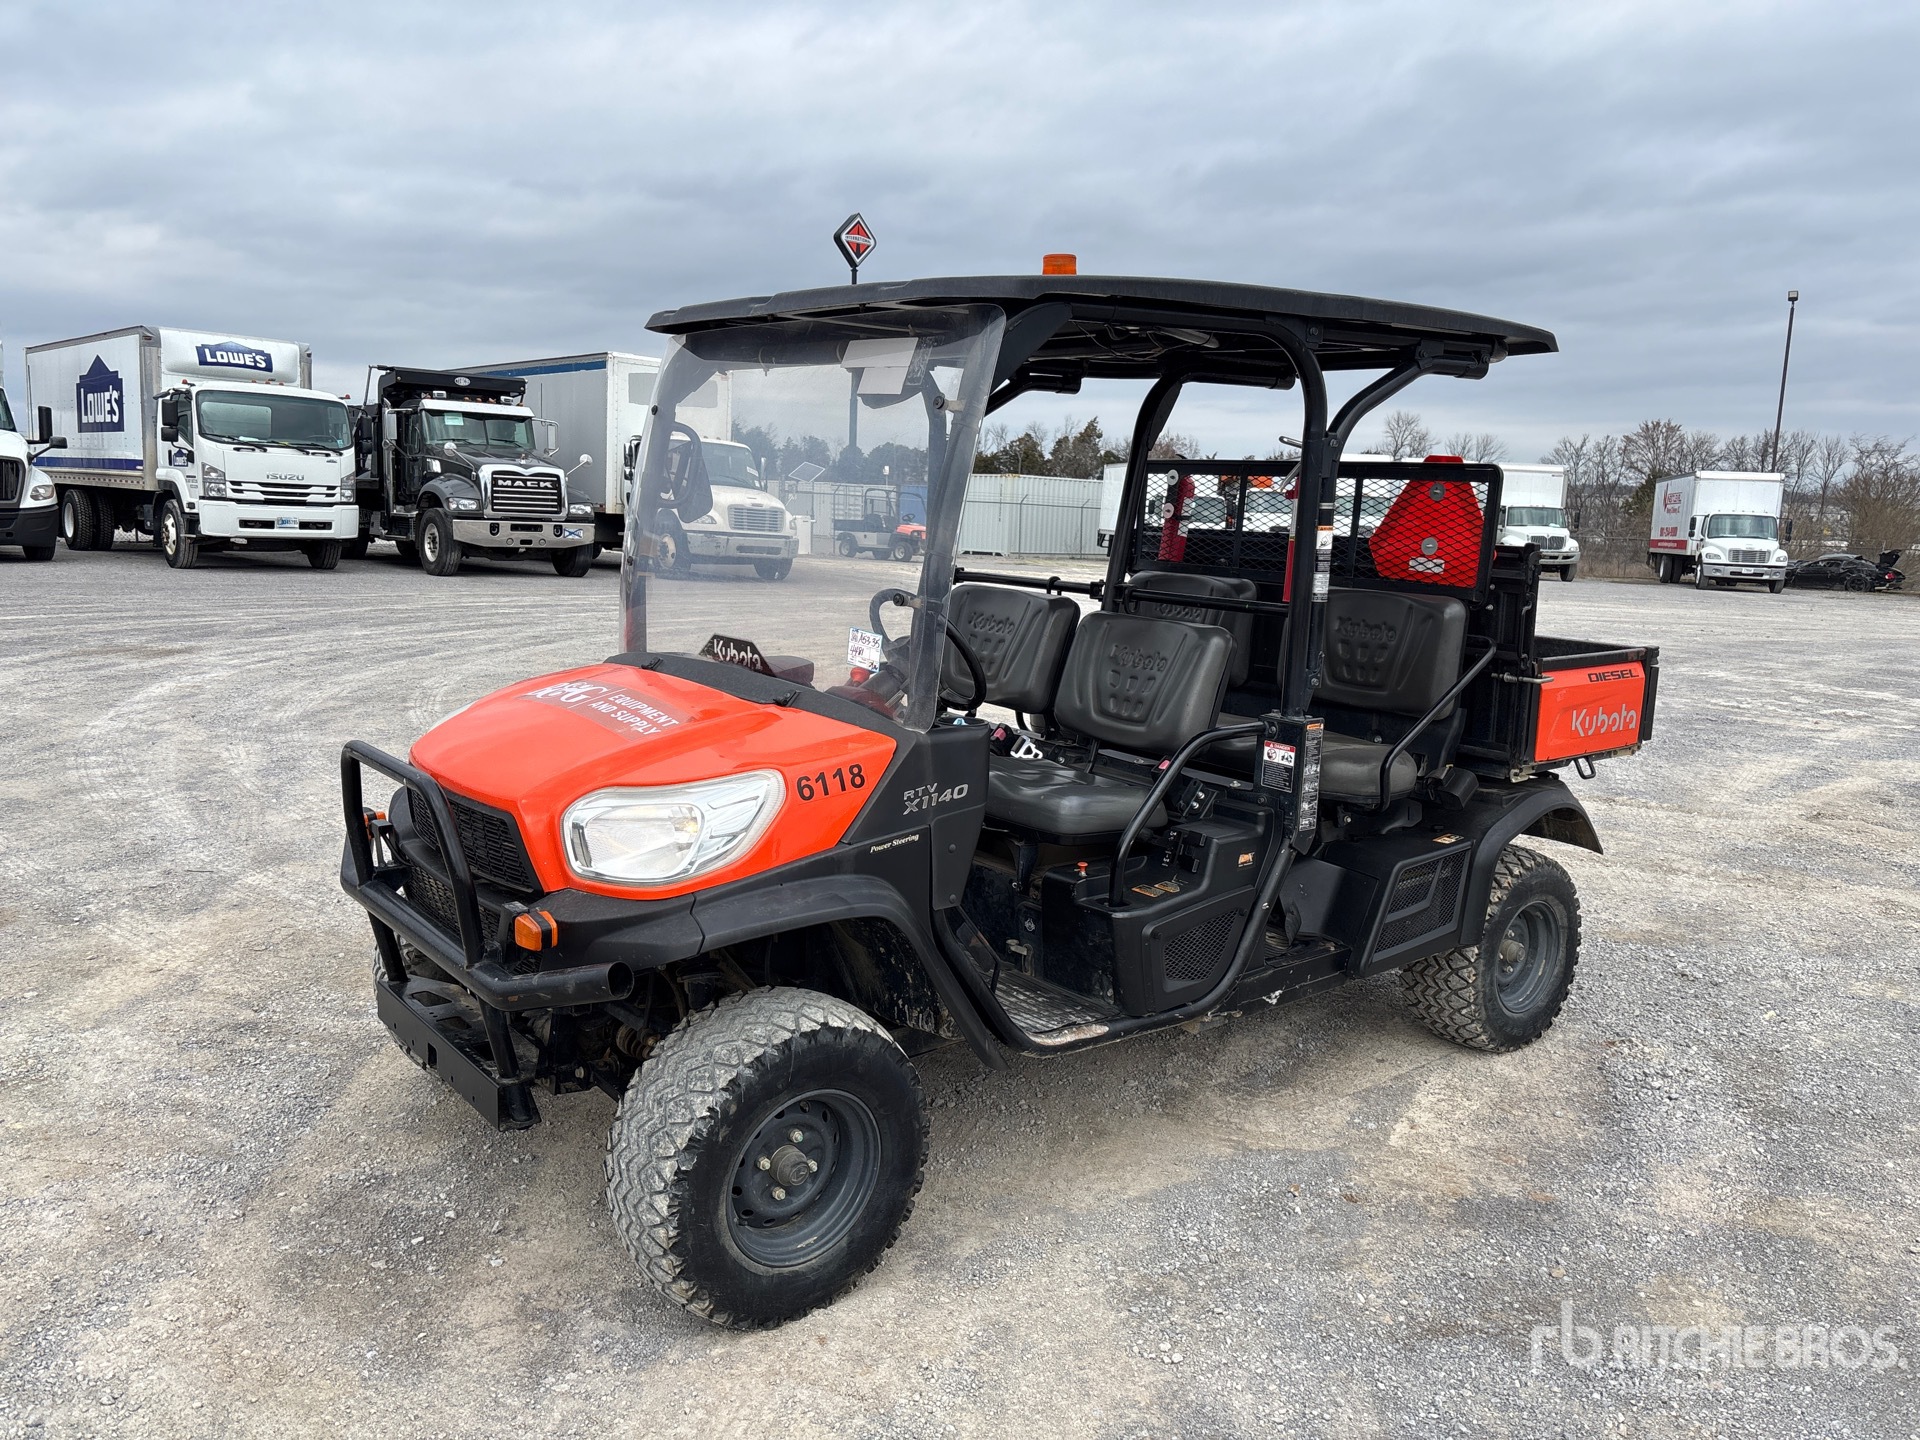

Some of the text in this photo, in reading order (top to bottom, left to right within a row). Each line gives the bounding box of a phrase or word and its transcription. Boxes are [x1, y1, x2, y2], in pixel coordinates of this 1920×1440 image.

[204, 348, 267, 368] LOWE'S
[80, 384, 120, 423] LOWE'S
[266, 471, 305, 481] ISUZU
[497, 479, 554, 488] MACK
[713, 638, 764, 670] Kubota
[1587, 668, 1640, 683] DIESEL
[587, 701, 662, 735] AND SUPPLY
[608, 693, 680, 728] EQUIPMENT
[1571, 703, 1637, 737] Kubota
[796, 763, 867, 802] 6118
[903, 782, 938, 801] RTV
[902, 783, 969, 816] X1140
[870, 834, 920, 854] Power Steering
